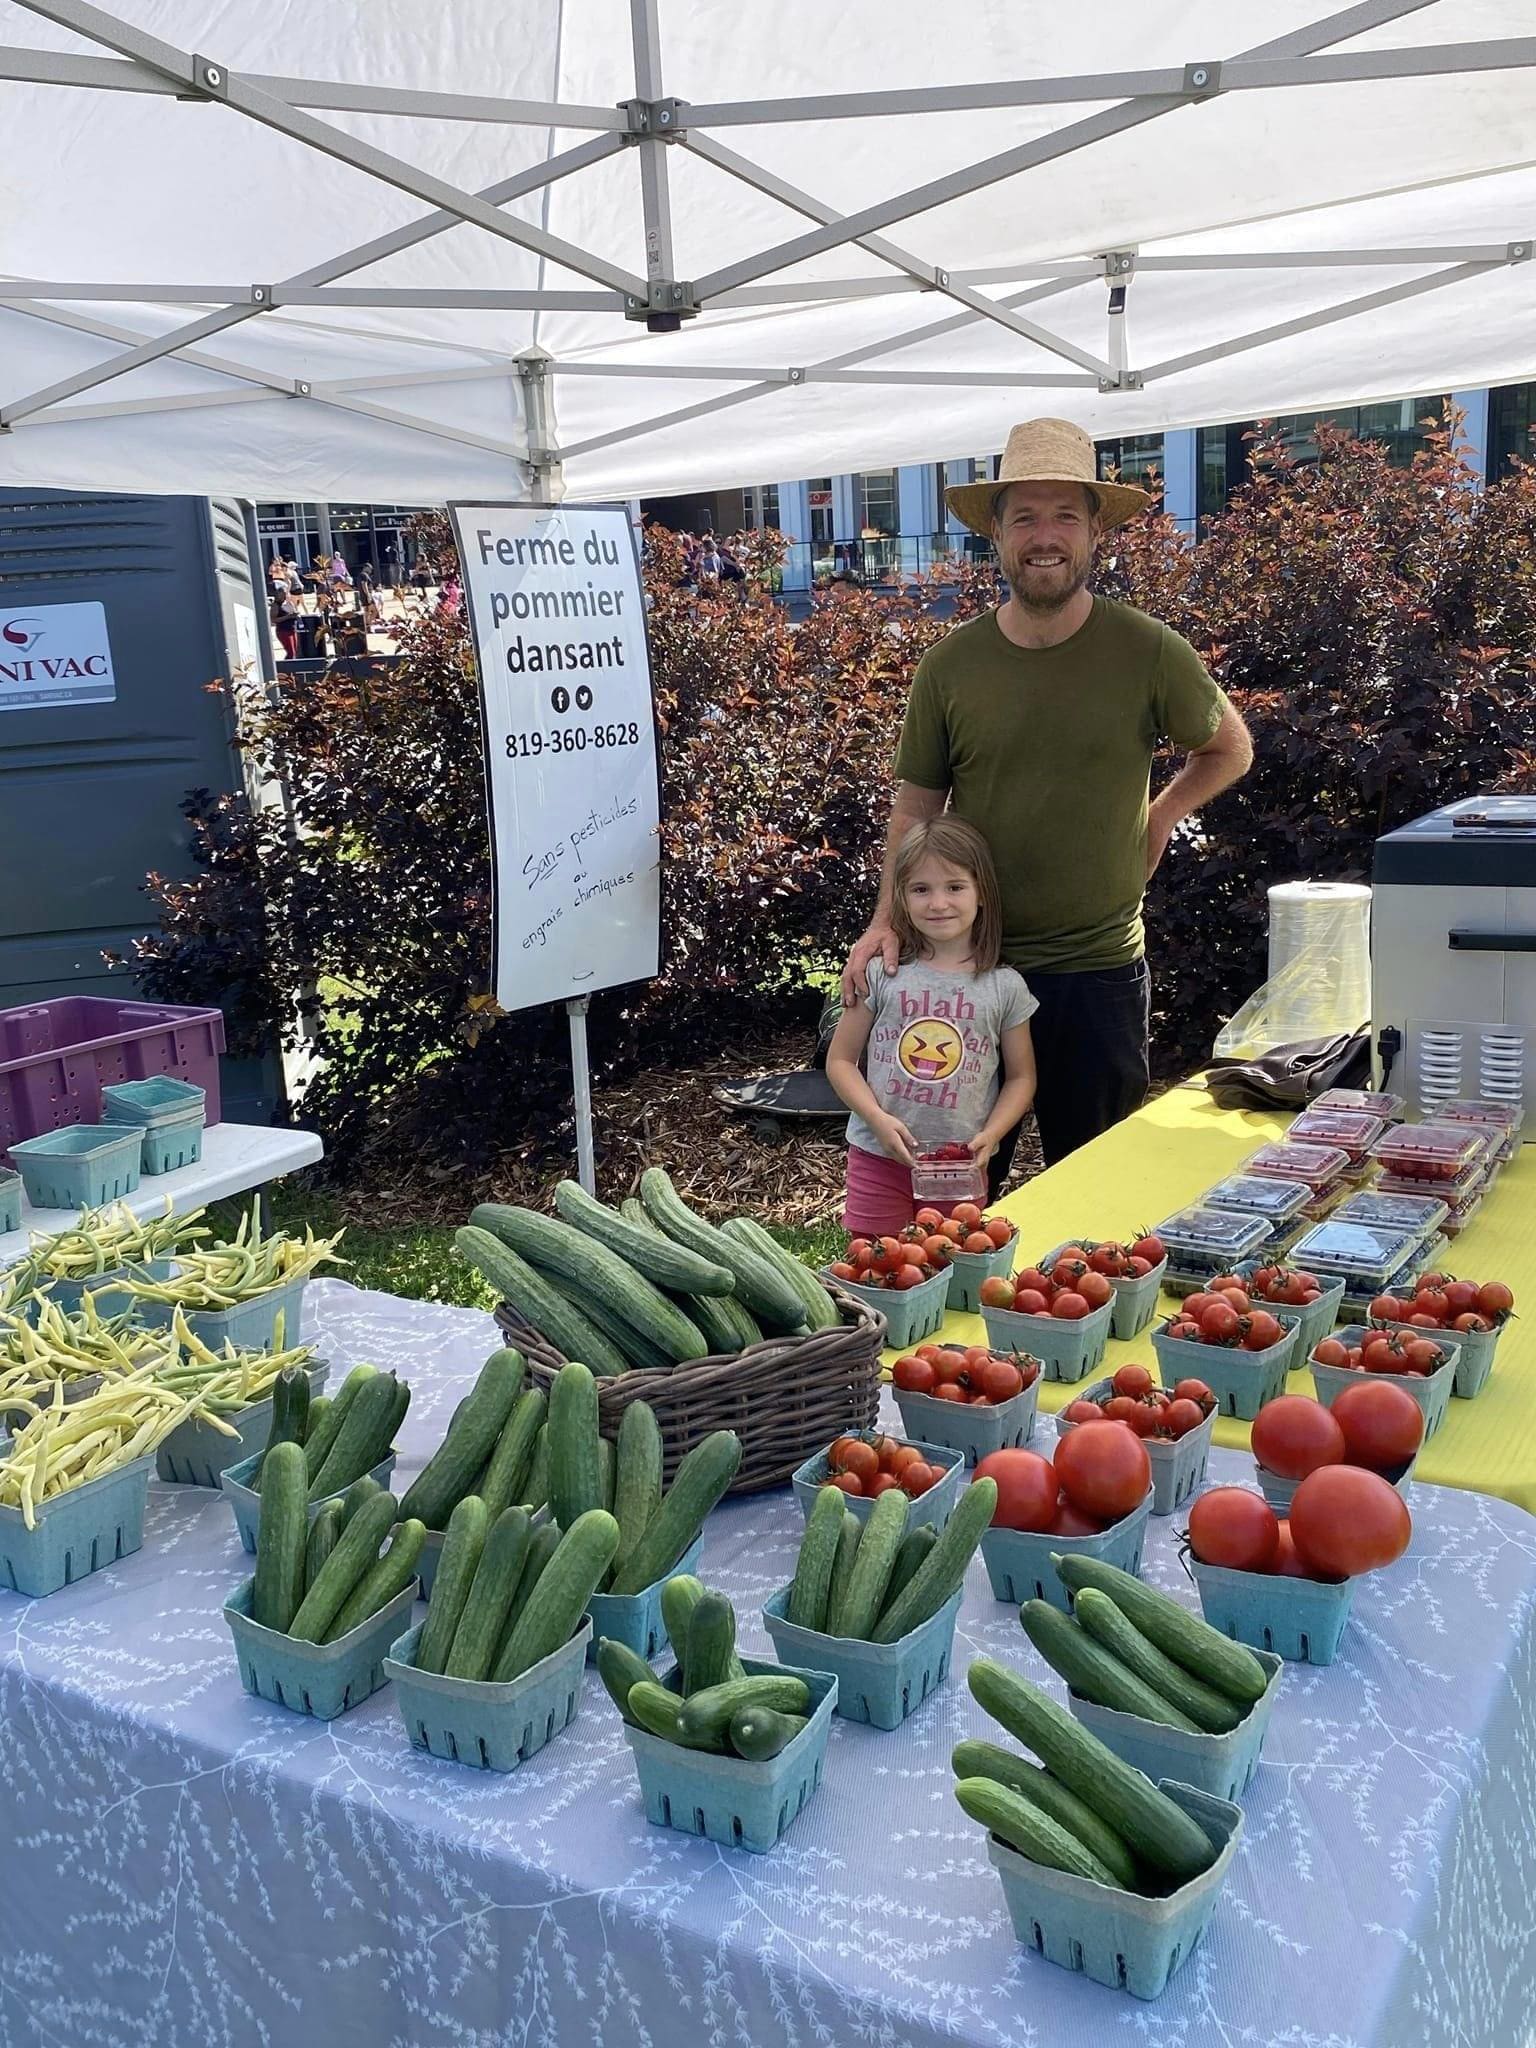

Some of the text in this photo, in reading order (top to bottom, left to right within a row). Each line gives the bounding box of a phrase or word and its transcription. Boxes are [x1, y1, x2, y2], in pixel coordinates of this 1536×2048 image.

[477, 529, 620, 566] Ferme du
[490, 581, 625, 629] pommier
[506, 635, 626, 674] dansant
[505, 722, 640, 759] 819-360-8628
[522, 795, 638, 890] Sans pesticides
[573, 871, 588, 884] ou
[522, 871, 635, 950] engrais chimiques
[899, 990, 975, 1020] blah
[963, 1027, 989, 1056] lah
[962, 1056, 982, 1073] lah
